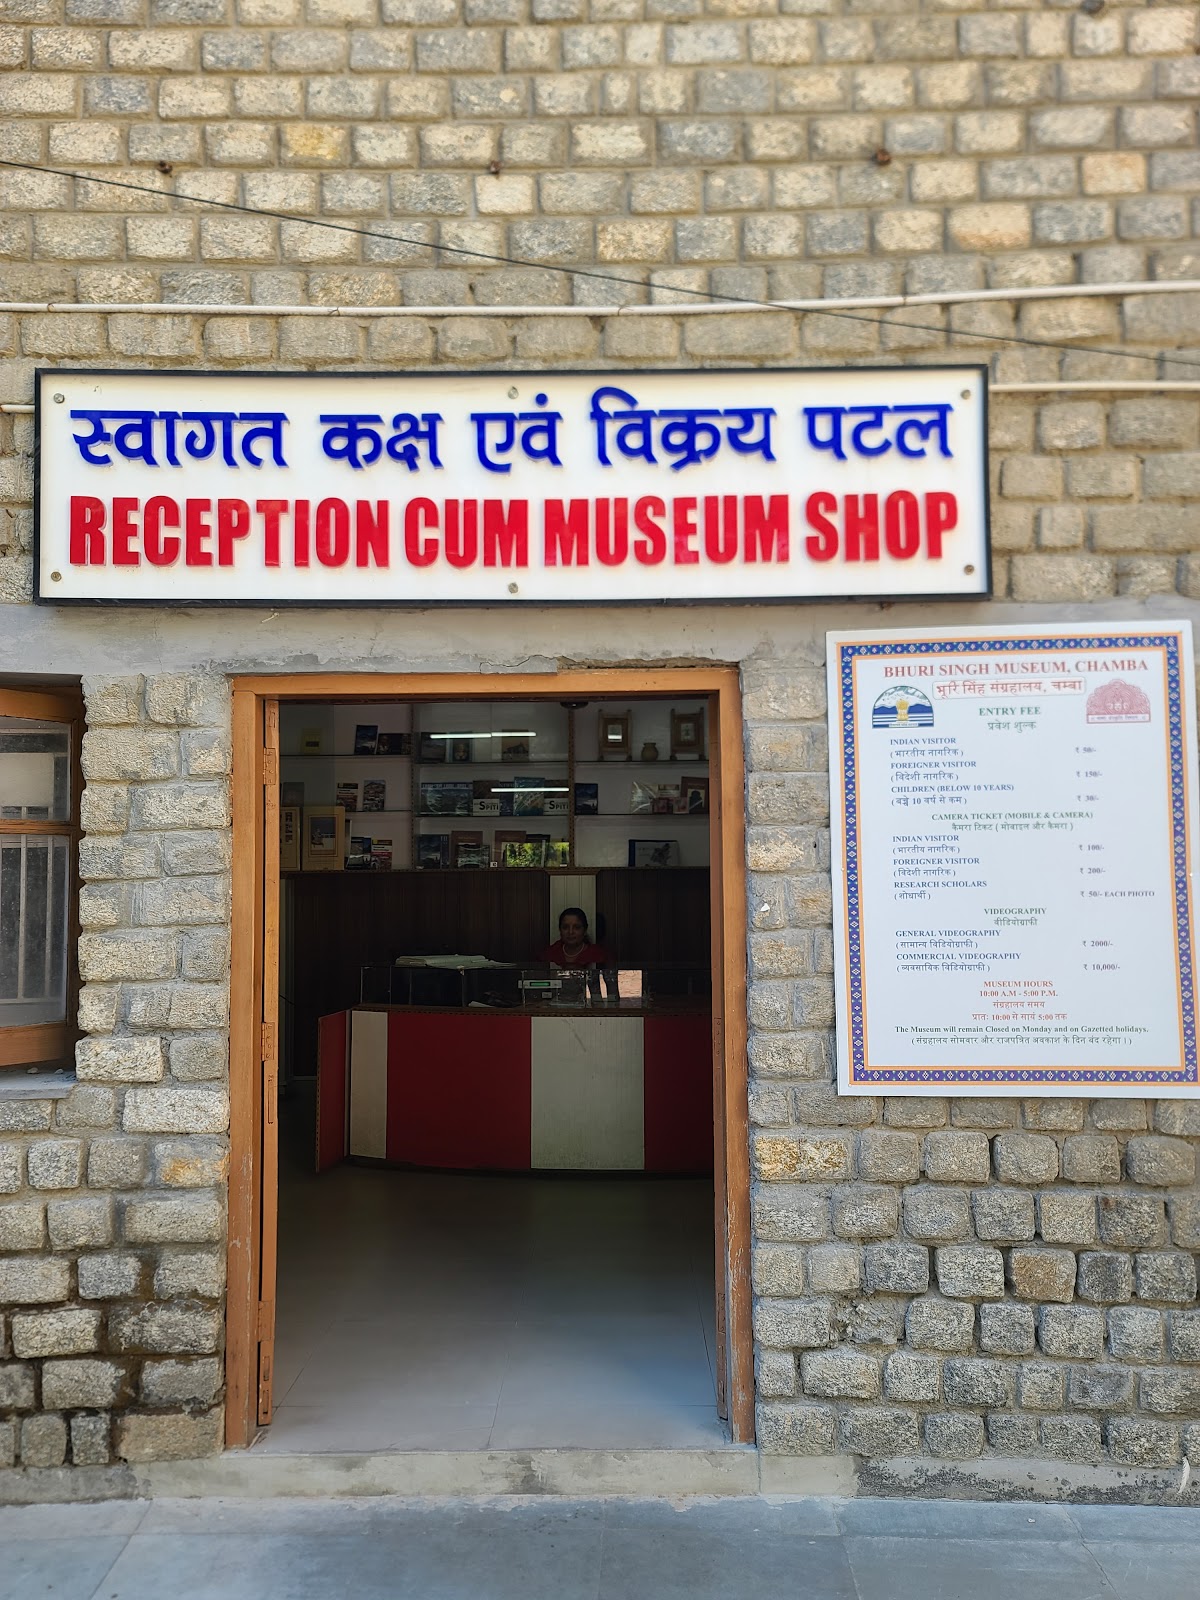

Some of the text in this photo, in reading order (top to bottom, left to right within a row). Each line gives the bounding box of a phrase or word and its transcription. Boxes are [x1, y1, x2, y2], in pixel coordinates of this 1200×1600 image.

[70, 385, 953, 472] स्वागत कक्ष एवं विक्रय पटल
[68, 489, 958, 568] RECEPTION CUM MUSEUM SHOP
[883, 660, 1148, 678] BHURI SINGH MUSEUM, CHAMBA
[962, 680, 985, 697] सिंह
[990, 681, 1046, 695] संग्रहालय,
[1050, 680, 1081, 692] चम्बा
[979, 707, 1041, 716] ENTRY FEE
[988, 720, 1037, 733] प्रवेश शुल्क
[937, 785, 971, 793] (BELOW
[923, 795, 936, 804] वर्ष
[939, 796, 946, 804] से
[479, 801, 499, 810] SPITI
[1005, 812, 1041, 820] (MOBILE
[952, 822, 971, 831] कैमरा
[1033, 822, 1045, 830] और
[984, 907, 1047, 915] VIDEOGRAPHY
[994, 917, 1038, 926] वीडियोग्राफी
[992, 1000, 1025, 1010] संग्रहालय
[1012, 1011, 1018, 1020] से
[1020, 1011, 1036, 1020] सायं
[985, 1025, 1009, 1033] Closed
[1081, 1025, 1113, 1033] Gazetted
[1116, 1025, 1149, 1033] holidays.
[950, 1035, 978, 1044] सोमवार
[981, 1035, 994, 1044] और
[996, 1034, 1030, 1044] राजपत्रित
[1063, 1034, 1070, 1044] के
[1072, 1035, 1086, 1044] दिन
[1088, 1035, 1099, 1044] बंद
